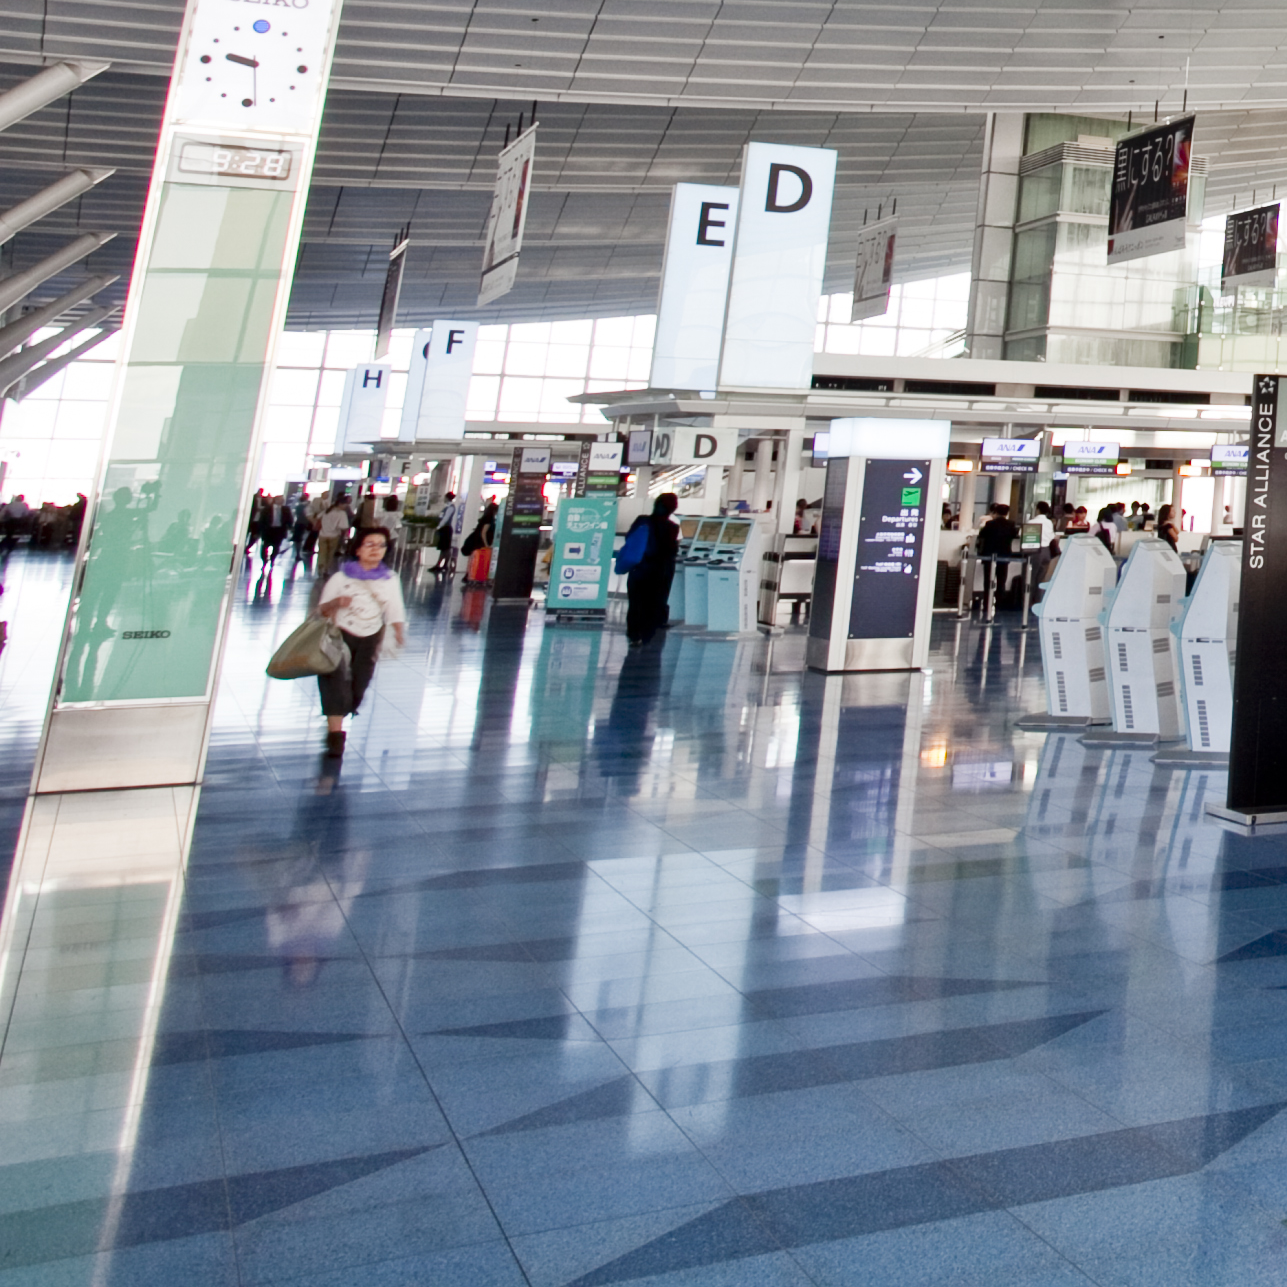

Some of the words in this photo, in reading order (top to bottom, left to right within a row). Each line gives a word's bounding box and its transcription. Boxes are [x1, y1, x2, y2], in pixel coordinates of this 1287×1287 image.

[212, 150, 285, 176] 9:28
[764, 162, 813, 214] D
[696, 201, 730, 247] E
[446, 329, 465, 355] F
[362, 369, 383, 389] H
[659, 433, 671, 458] D
[693, 434, 718, 459] D
[1253, 403, 1274, 509] ALLIANCE
[401, 462, 411, 474] F
[577, 452, 589, 496] ALLIANCE
[882, 515, 919, 524] Departures
[1249, 514, 1267, 569] STAR
[122, 630, 172, 640] SEIKO
